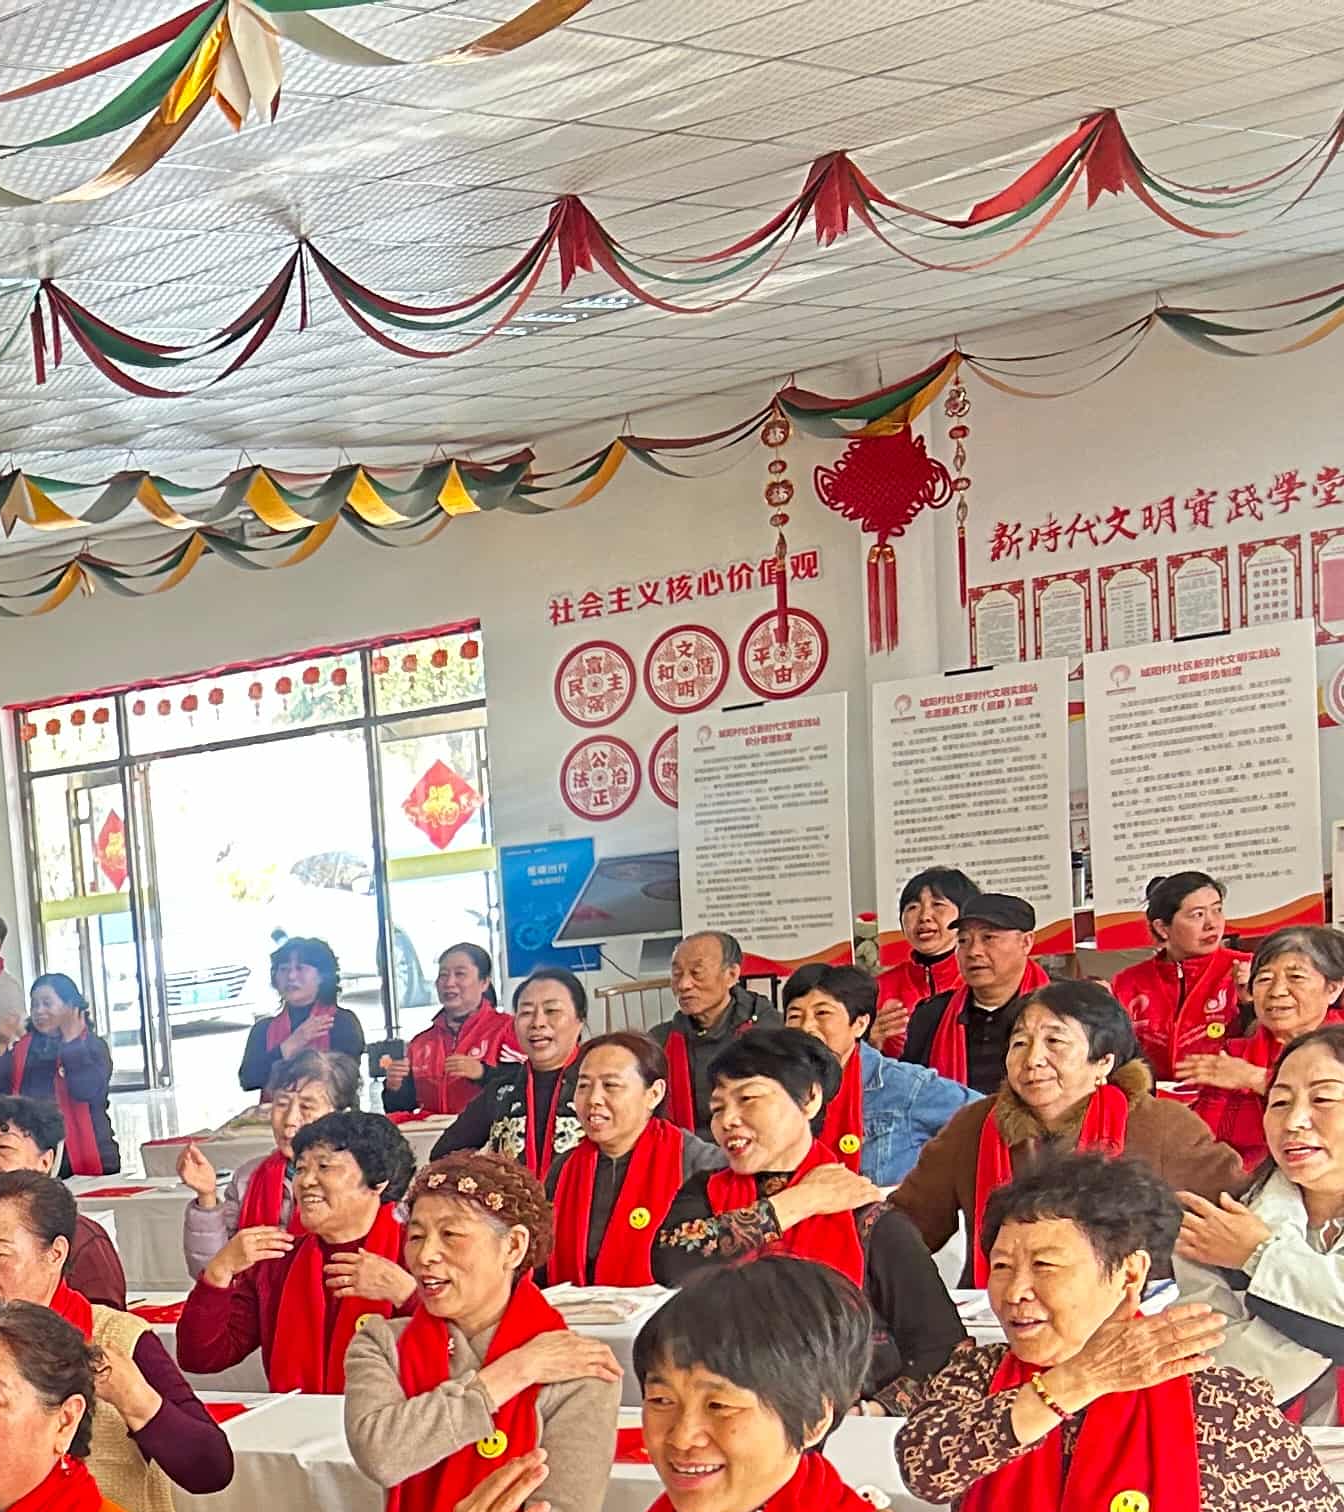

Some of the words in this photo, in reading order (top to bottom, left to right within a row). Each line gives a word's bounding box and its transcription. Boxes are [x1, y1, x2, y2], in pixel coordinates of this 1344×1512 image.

[549, 551, 819, 626] 社会主义核心价值观
